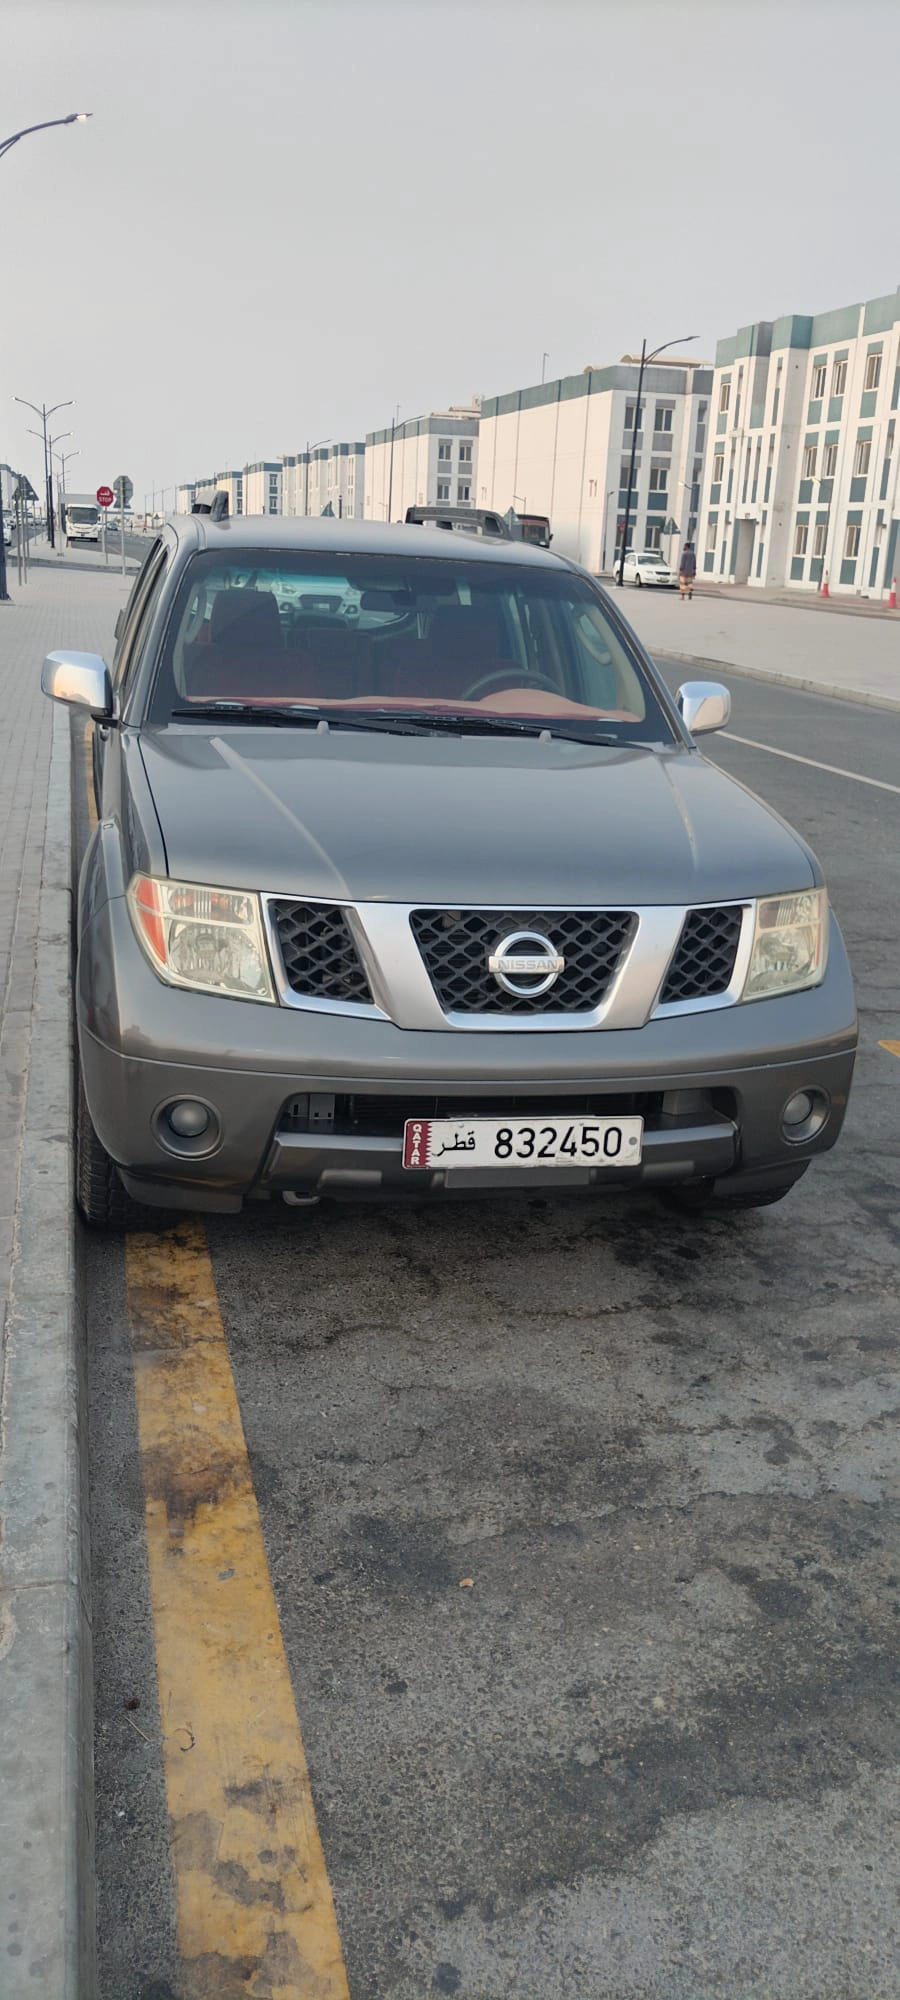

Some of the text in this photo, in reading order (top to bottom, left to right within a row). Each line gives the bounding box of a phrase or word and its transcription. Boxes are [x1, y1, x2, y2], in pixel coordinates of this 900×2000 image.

[498, 959, 558, 970] NISSAN
[410, 1123, 423, 1165] QATAR
[431, 1130, 476, 1157] قطر
[494, 1126, 623, 1159] 832450
